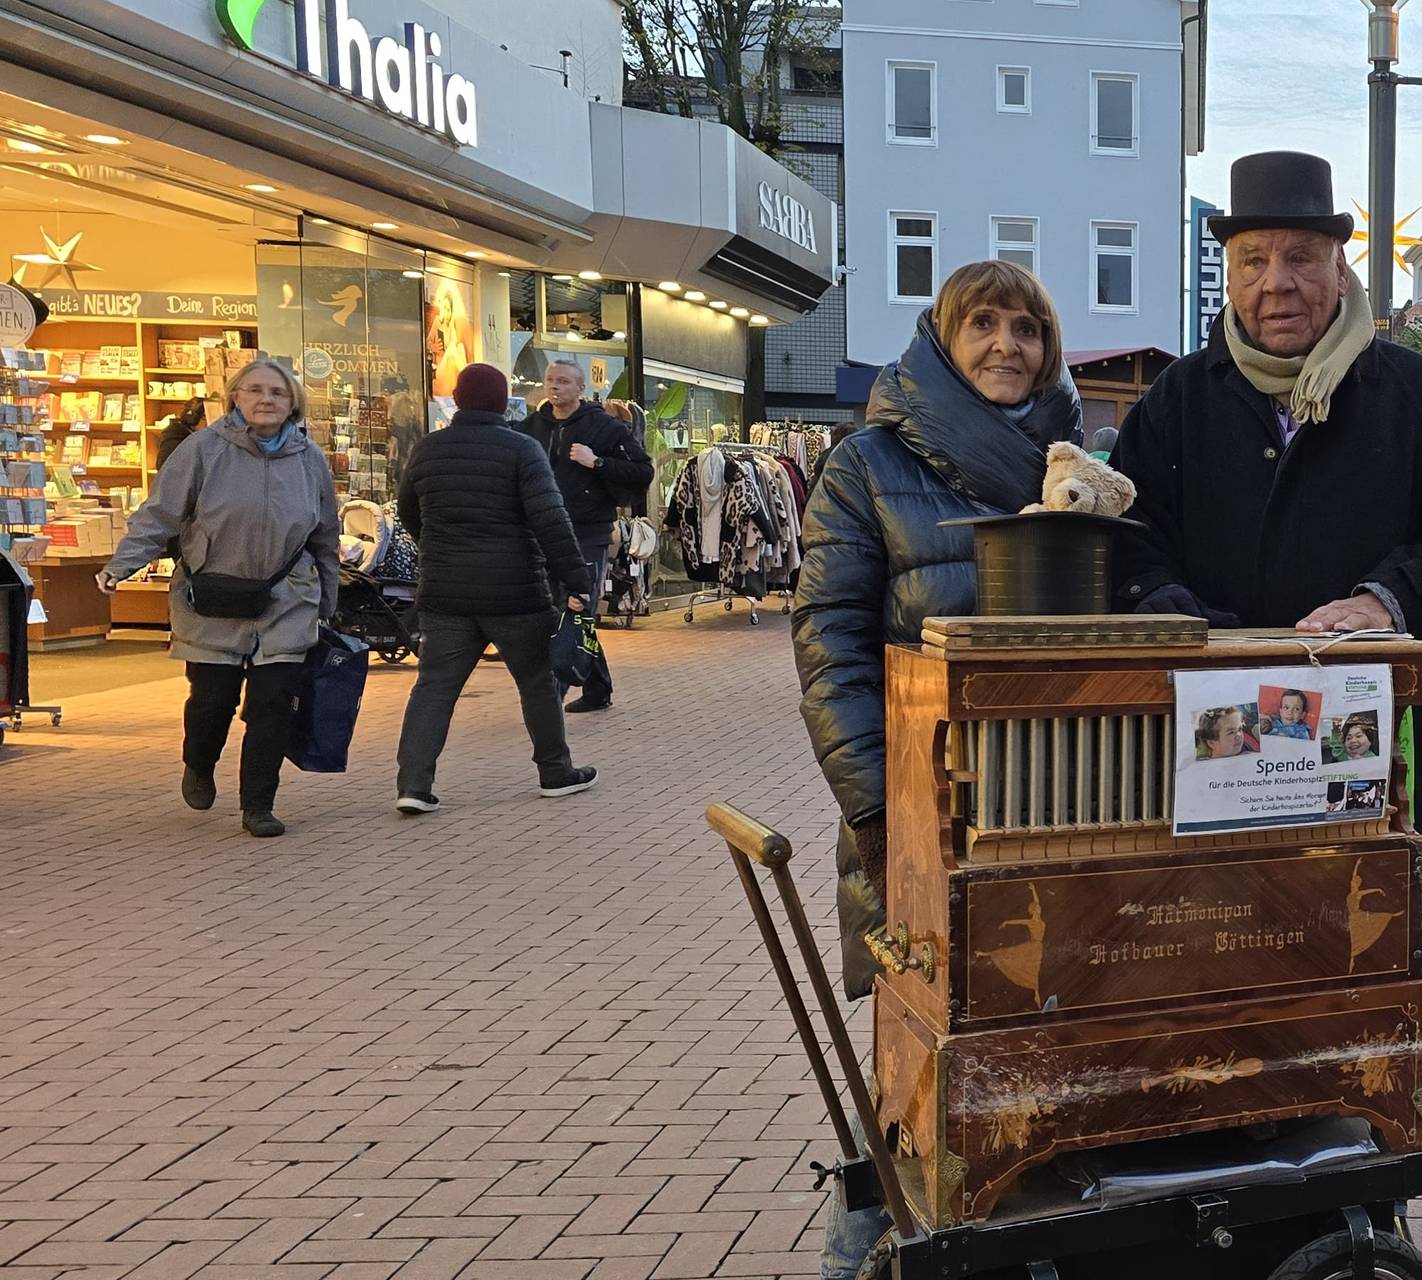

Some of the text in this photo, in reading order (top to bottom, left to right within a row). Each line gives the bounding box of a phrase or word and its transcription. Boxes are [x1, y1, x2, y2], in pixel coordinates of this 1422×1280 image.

[759, 180, 818, 255] SABBA
[83, 292, 142, 318] NEUES?
[212, 295, 258, 321] Region
[1256, 757, 1316, 777] Spende
[1208, 780, 1221, 790] für
[1223, 780, 1235, 789] die
[1237, 778, 1273, 788] Deutsche
[1089, 942, 1185, 965] Hofbauer
